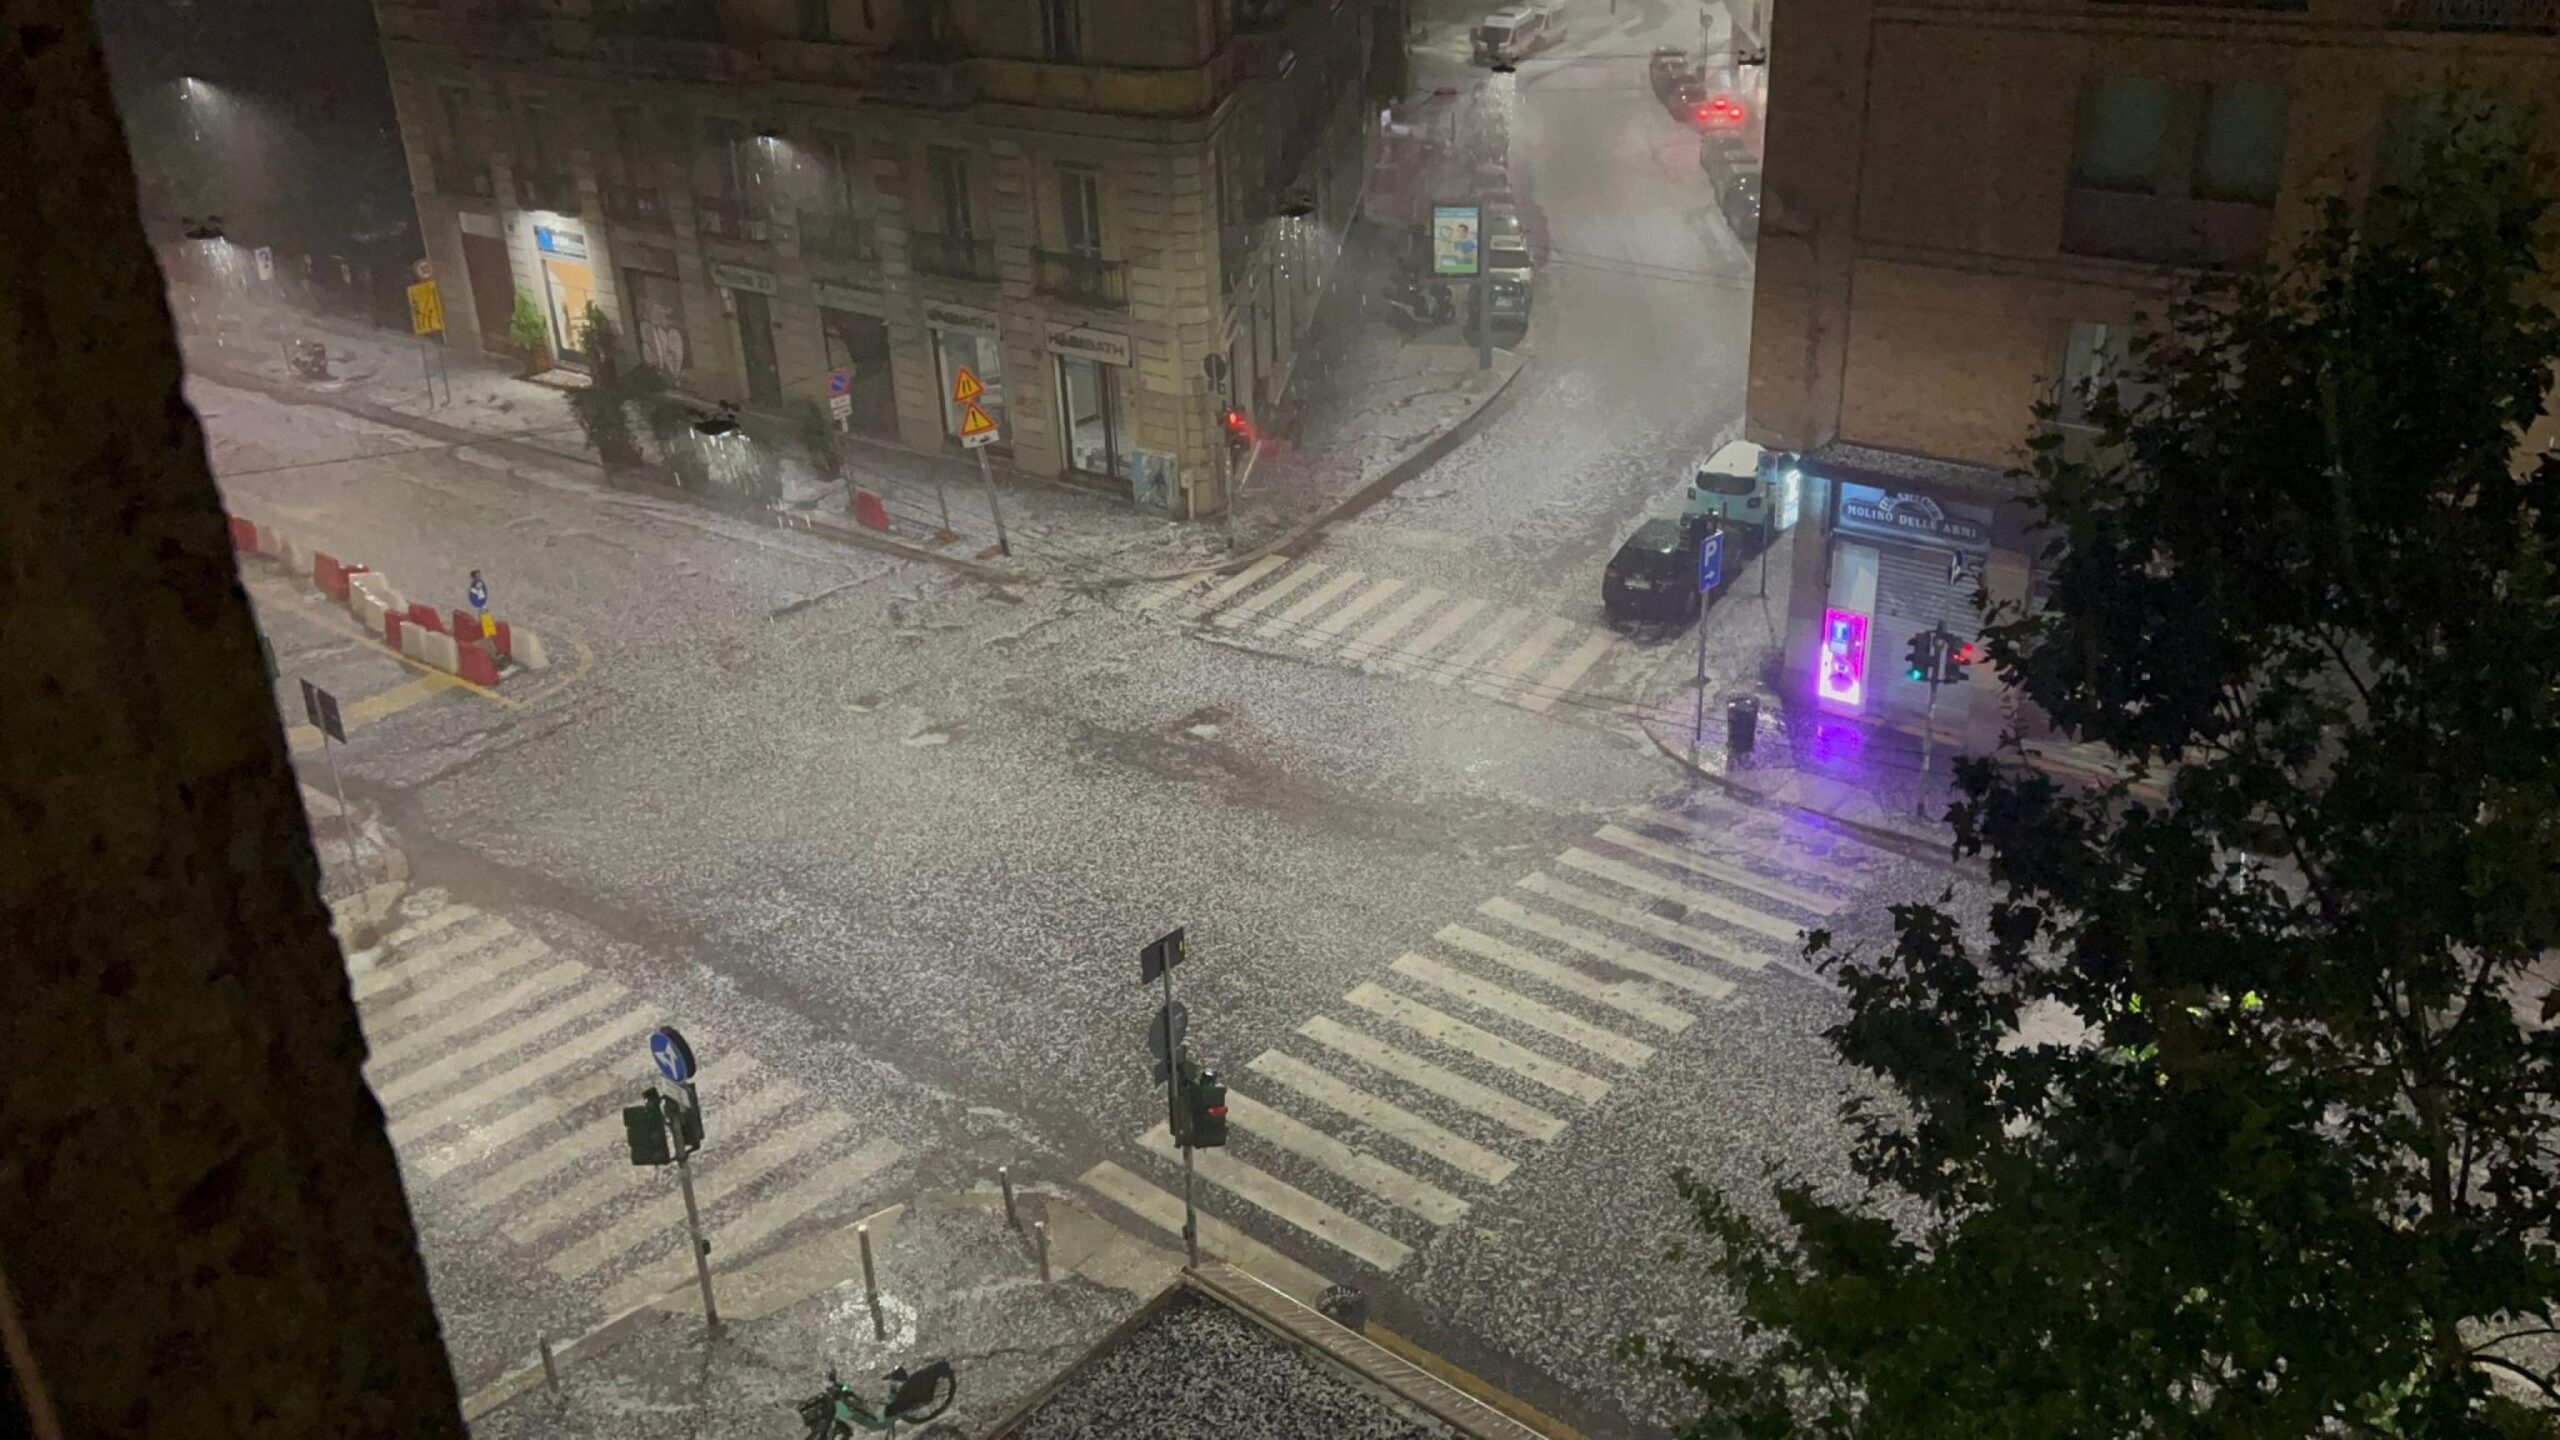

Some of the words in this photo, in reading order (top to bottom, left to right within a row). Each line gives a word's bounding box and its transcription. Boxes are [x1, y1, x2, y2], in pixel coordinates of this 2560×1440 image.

[1847, 504, 1893, 522] MOLINO
[1899, 514, 1937, 531] DELLE
[1943, 523, 1977, 539] ARMI
[1704, 540, 1718, 567] P
